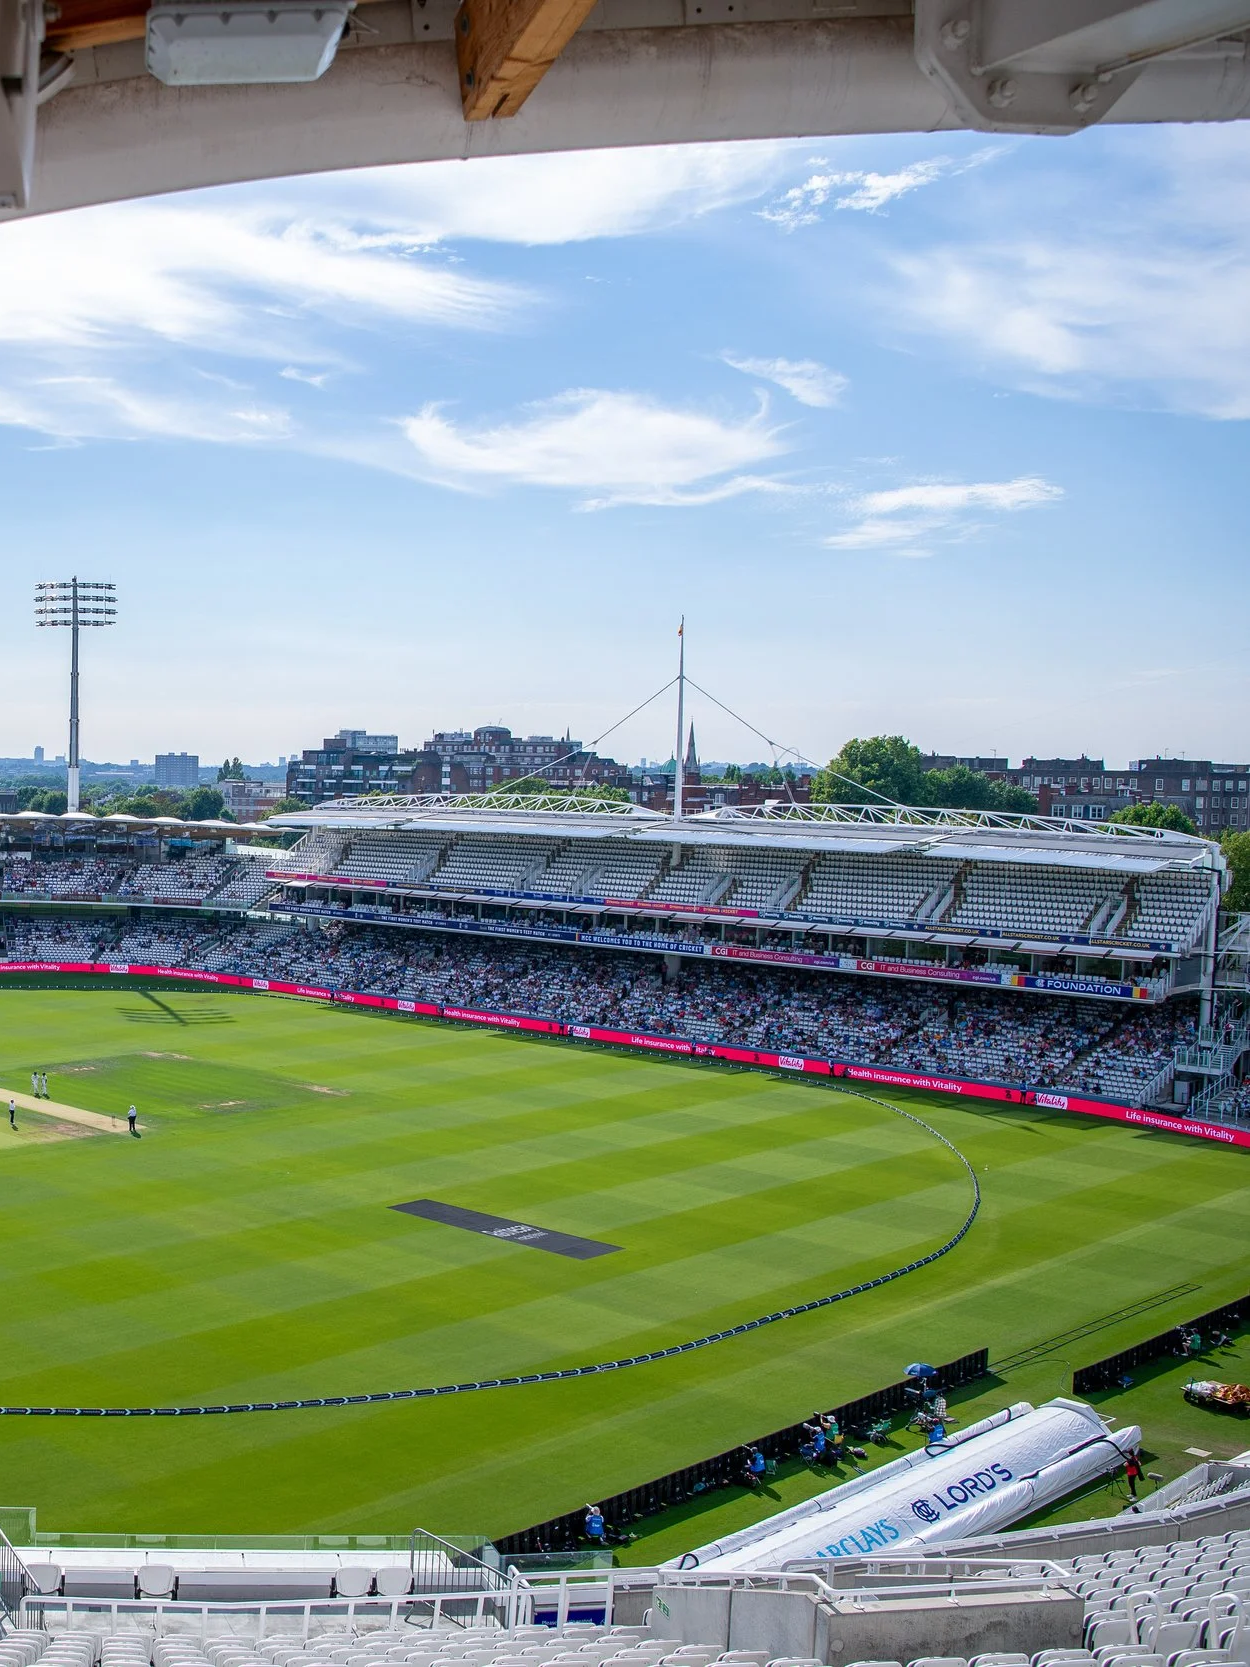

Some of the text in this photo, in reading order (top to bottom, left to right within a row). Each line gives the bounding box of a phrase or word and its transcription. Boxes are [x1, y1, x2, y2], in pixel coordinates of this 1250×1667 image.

[593, 935, 621, 944] WELCOMES
[678, 944, 702, 952] CRICKET
[715, 947, 728, 956] CGI
[774, 954, 803, 963] Consulting
[860, 962, 875, 971] CGI
[899, 966, 927, 975] Business
[927, 969, 960, 979] Consulting
[1047, 980, 1121, 995] FOUNDATION
[444, 1008, 520, 1027] Health insurance with Vitality
[631, 1036, 643, 1044] Life
[644, 1038, 674, 1049] insurance
[676, 1043, 690, 1051] with
[780, 1056, 803, 1069] Vitality
[848, 1068, 962, 1093] Health insurance with Vitality
[1037, 1093, 1066, 1109] Vitality
[1125, 1111, 1235, 1142] Life insurance with Vitality
[933, 1463, 1013, 1511] LORD'S
